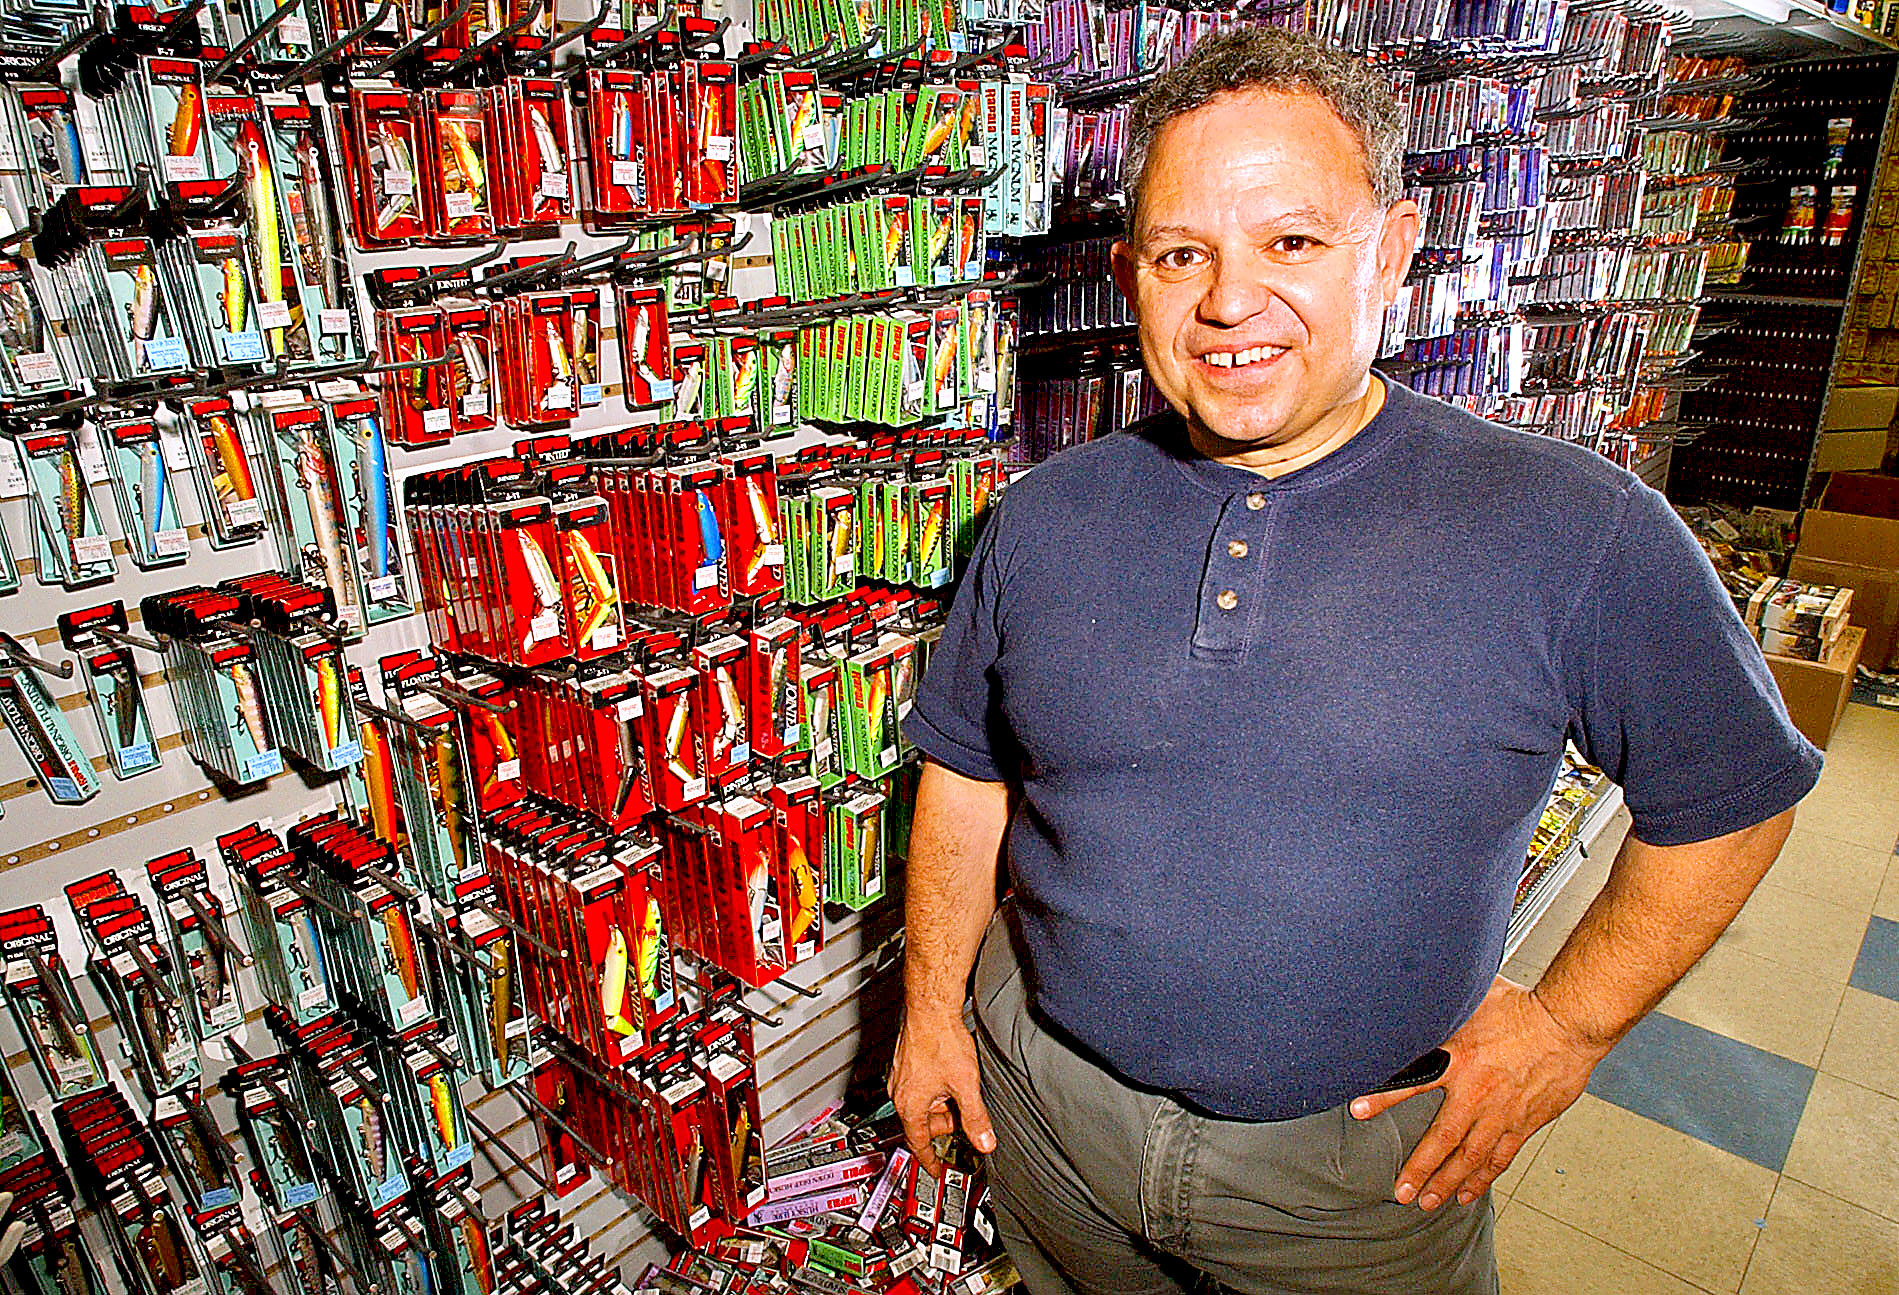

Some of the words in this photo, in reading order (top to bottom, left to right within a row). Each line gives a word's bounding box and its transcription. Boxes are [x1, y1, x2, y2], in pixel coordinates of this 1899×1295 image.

[1011, 139, 1021, 203] MAGNUM
[401, 671, 440, 689] FLOATING
[163, 872, 203, 891] ORIGINAL
[3, 932, 53, 950] ORIGINAL
[103, 922, 149, 946] ORIGINAL
